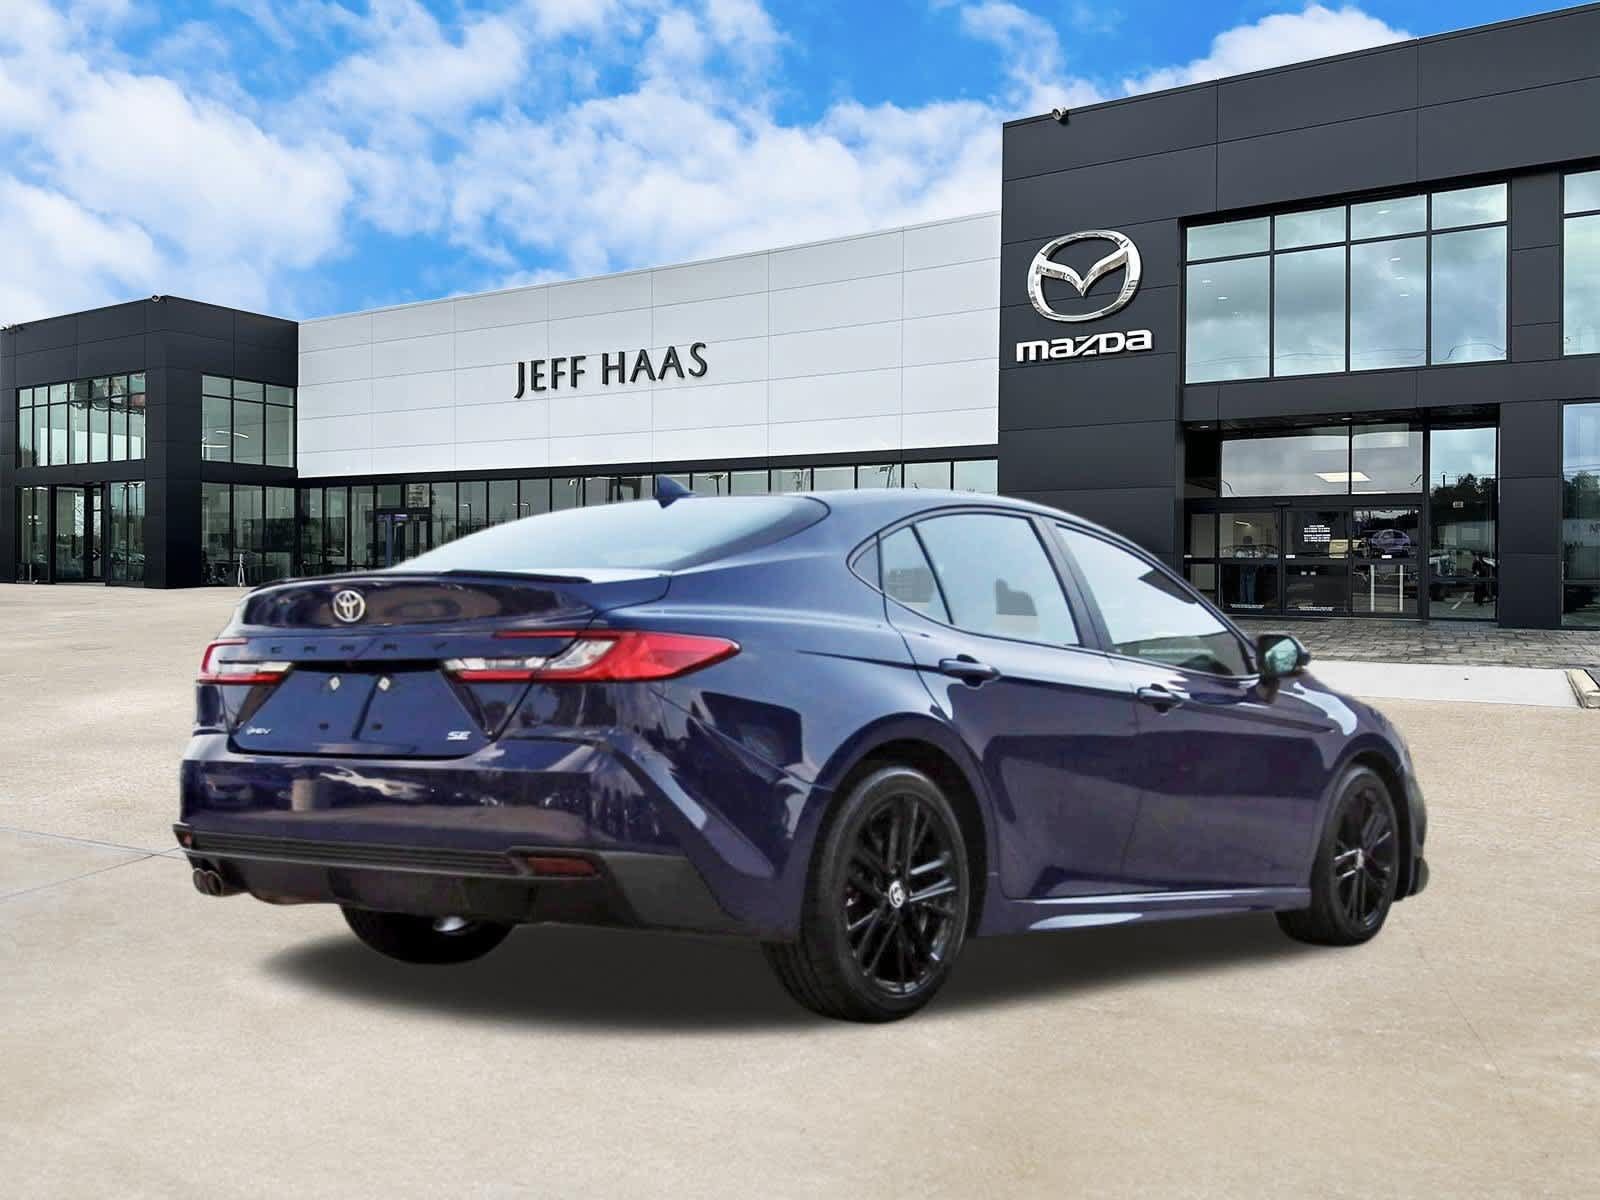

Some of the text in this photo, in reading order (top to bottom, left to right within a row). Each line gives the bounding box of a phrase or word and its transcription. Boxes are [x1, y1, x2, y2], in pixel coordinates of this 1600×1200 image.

[1016, 329, 1153, 362] mazda
[513, 341, 708, 399] JEFF HAAS
[446, 730, 472, 741] SE
